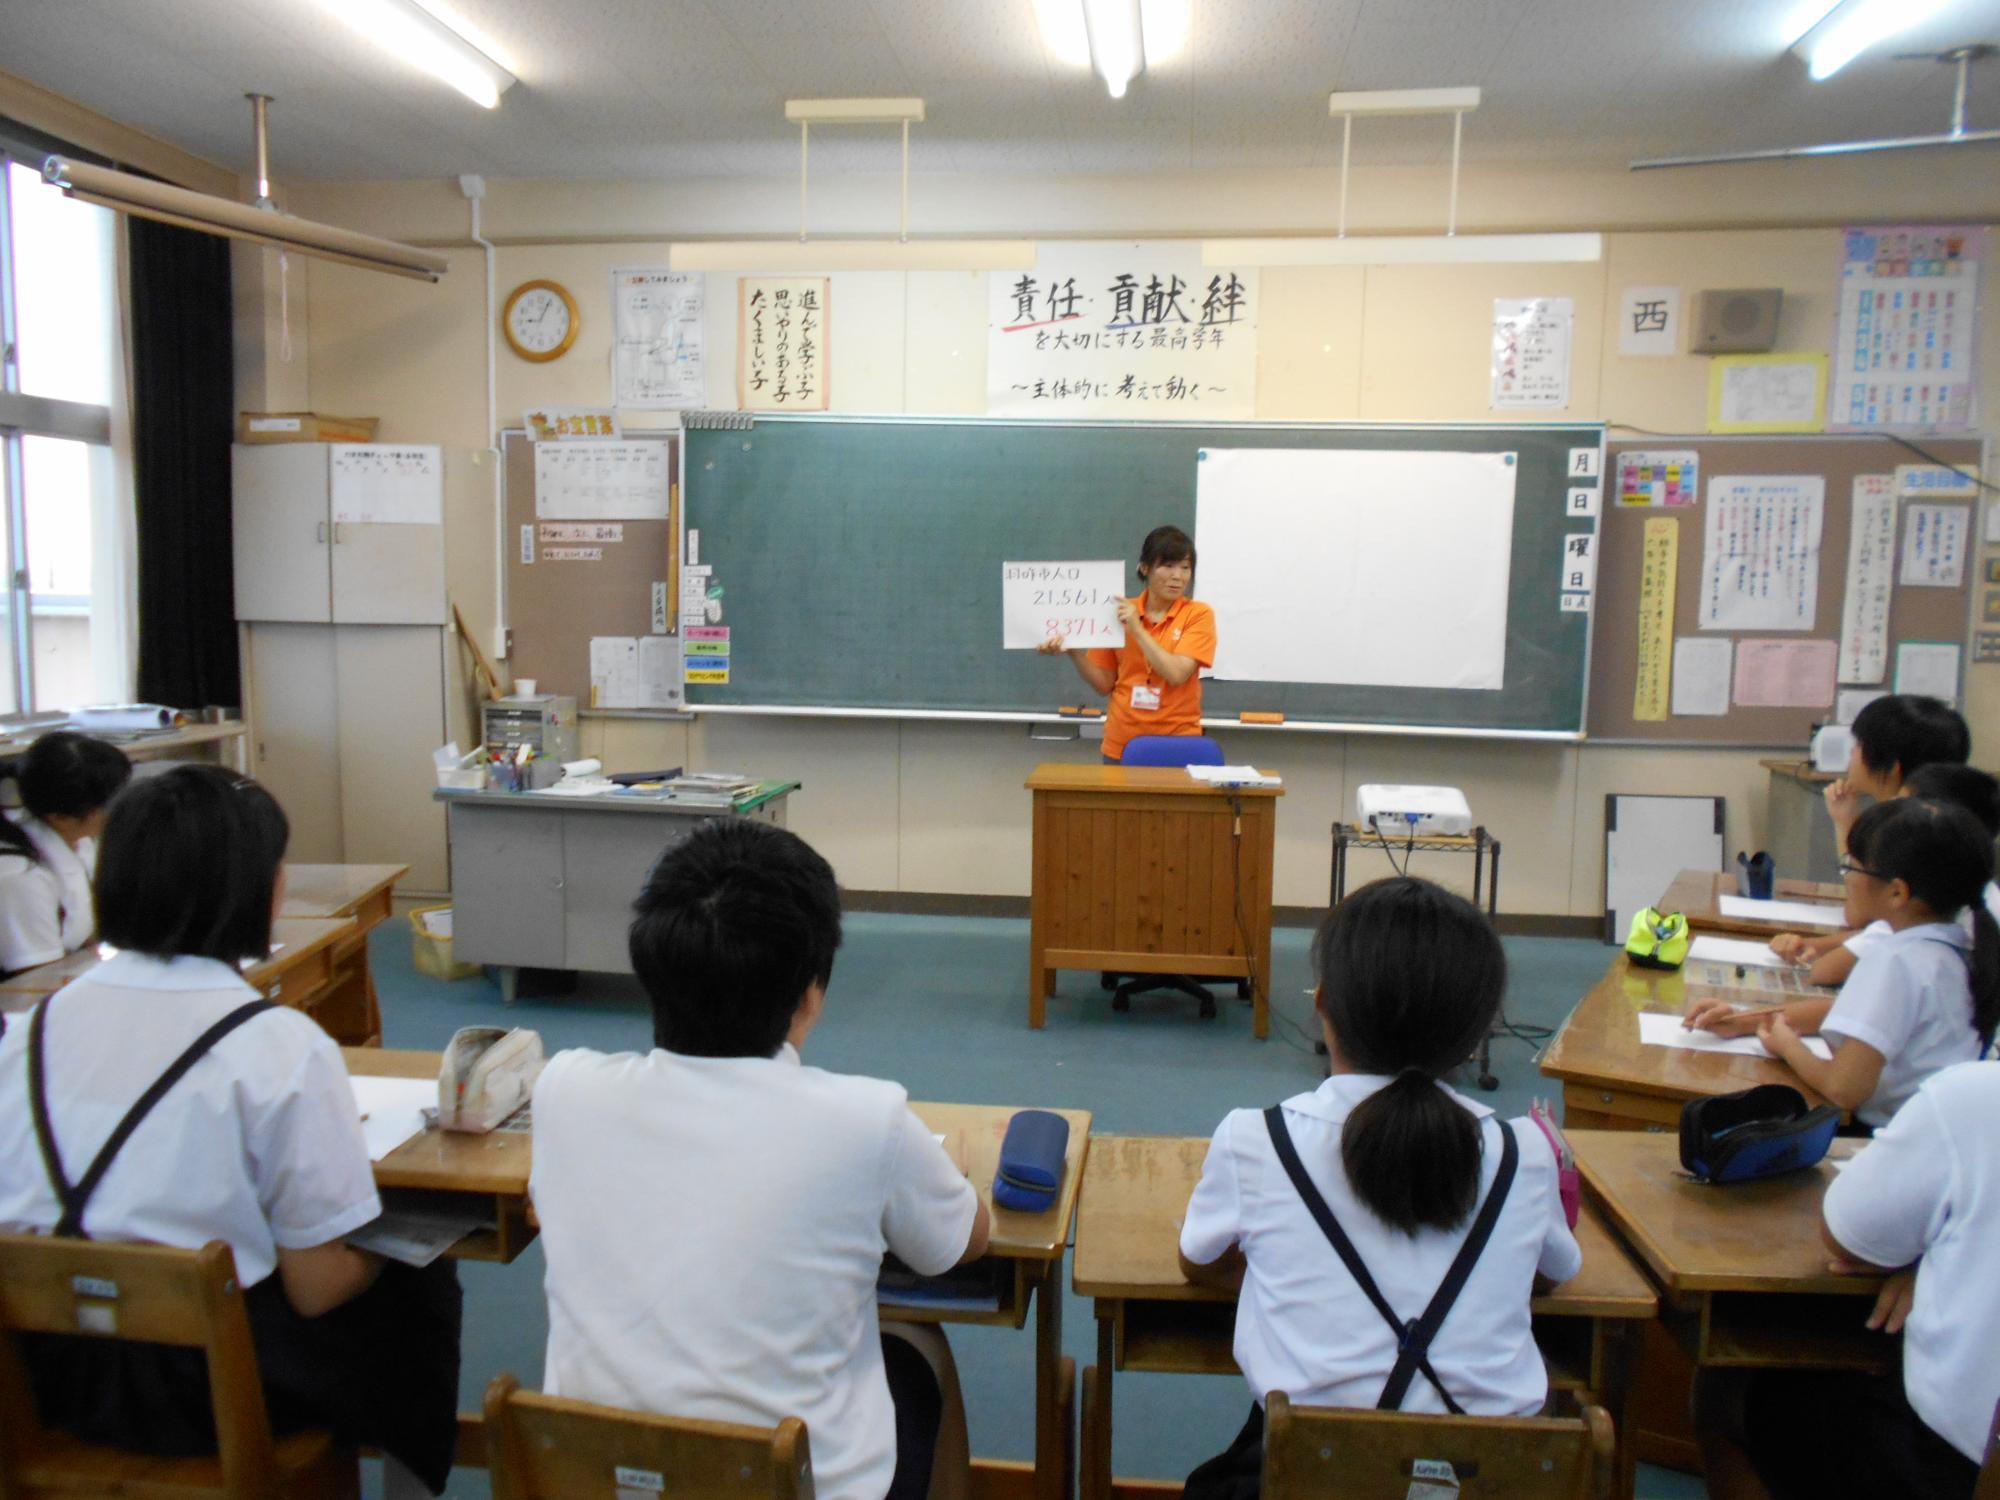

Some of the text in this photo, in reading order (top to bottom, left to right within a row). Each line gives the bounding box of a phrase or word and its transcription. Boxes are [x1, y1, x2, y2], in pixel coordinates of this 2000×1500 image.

[1634, 300, 1668, 334] 西
[750, 288, 769, 390] たくましい子
[773, 289, 793, 403] 思いやりのある子
[796, 289, 820, 400] 進んで学ぶ子
[1035, 327, 1226, 351] を大切にする最高学年
[1574, 453, 1590, 473] 月
[1573, 493, 1588, 510] 日
